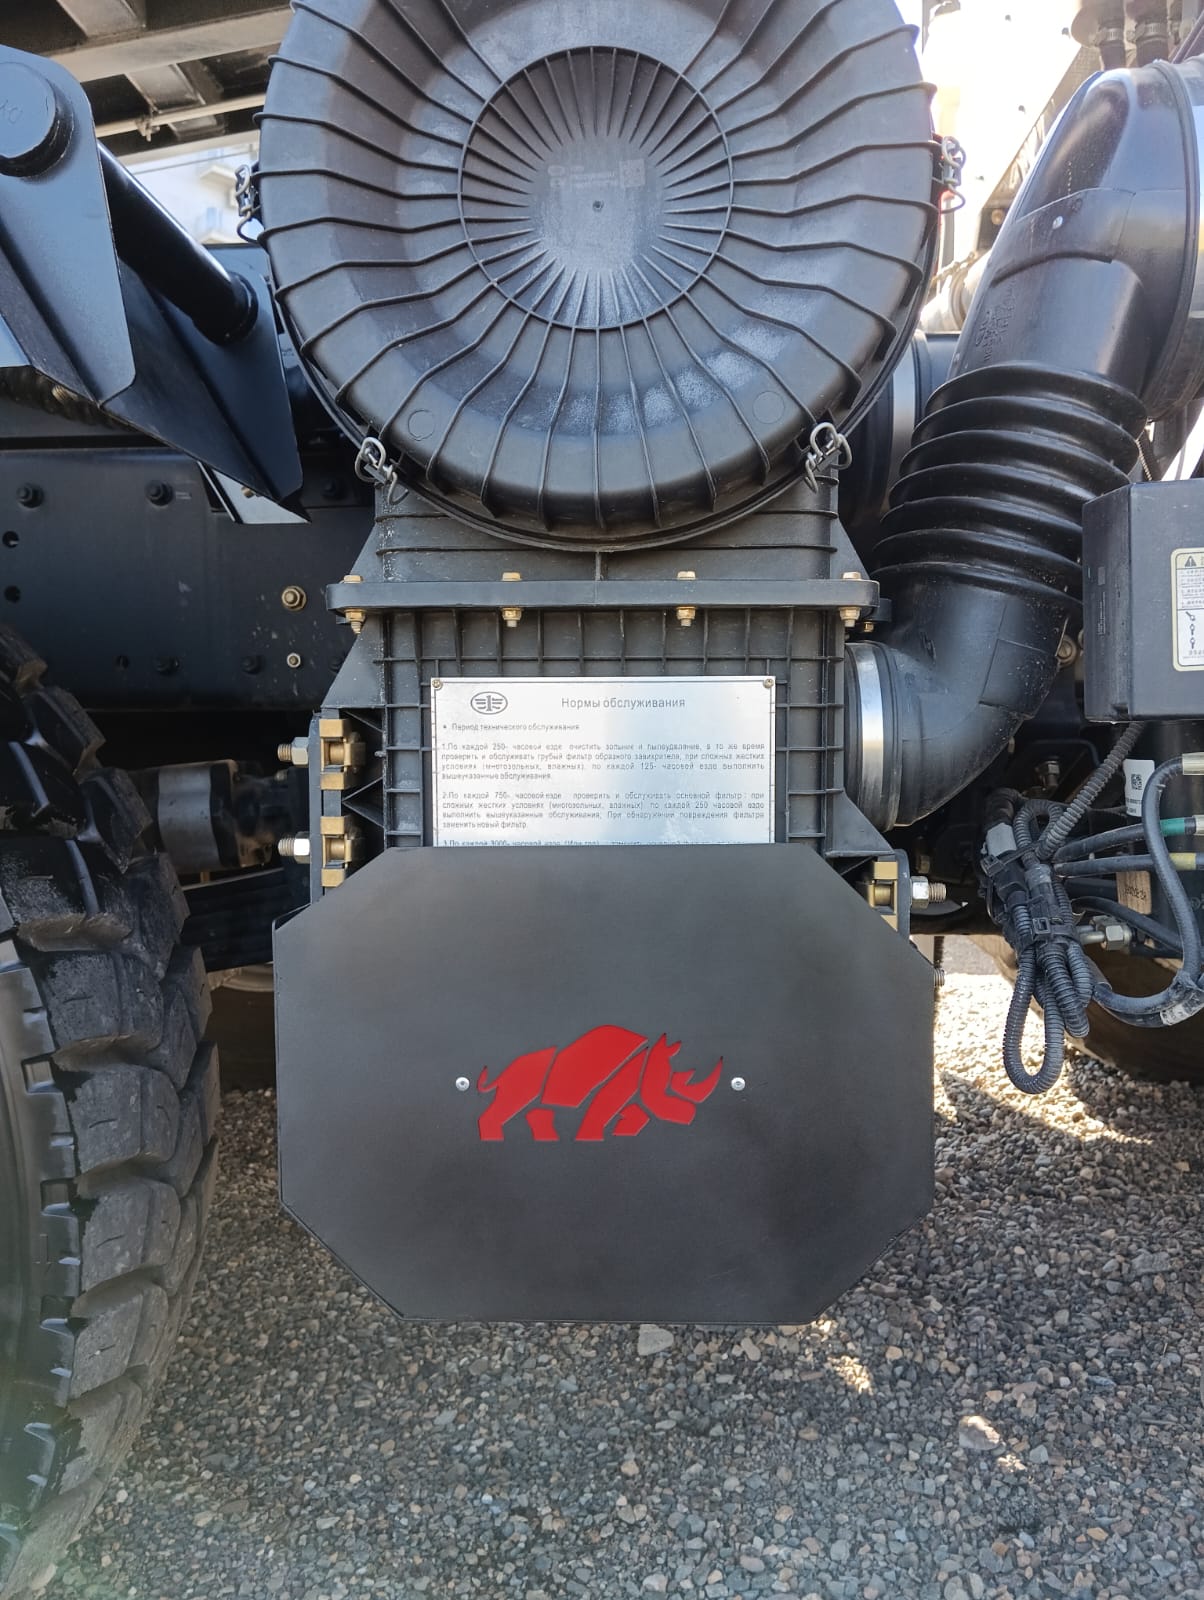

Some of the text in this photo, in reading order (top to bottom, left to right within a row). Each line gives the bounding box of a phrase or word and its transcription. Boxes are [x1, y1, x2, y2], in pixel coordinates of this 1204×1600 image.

[561, 696, 686, 711] Нормы обслуживания
[451, 722, 580, 732] Период технического обслуживания
[461, 742, 489, 752] каждой
[512, 742, 542, 751] часовой
[568, 743, 602, 751] очистить
[638, 743, 643, 751] и
[706, 743, 711, 751] в
[715, 743, 724, 751] то
[727, 743, 738, 751] же
[742, 743, 765, 752] время
[441, 753, 479, 762] проверить
[488, 752, 535, 762] обслуживать
[537, 752, 563, 762] грубый
[565, 753, 593, 762] фильтр
[684, 753, 699, 762] при
[441, 763, 477, 772] условиях
[606, 762, 635, 771] каждой
[661, 762, 694, 770] часовой
[441, 773, 499, 781] вышеуказанные
[442, 791, 459, 800] 2.По
[463, 791, 490, 801] каждой
[514, 791, 544, 800] часовой
[572, 792, 611, 801] проверить
[615, 792, 621, 800] и
[624, 791, 672, 802] обслуживать
[673, 791, 711, 800] основной
[750, 792, 765, 801] при
[511, 802, 545, 811] условиях
[663, 800, 691, 811] каждой
[694, 801, 709, 809] 250
[712, 801, 743, 809] часовой
[485, 811, 544, 820] вышеуказанные
[607, 810, 623, 820] При
[679, 811, 729, 820] повреждения
[476, 819, 499, 829] новый
